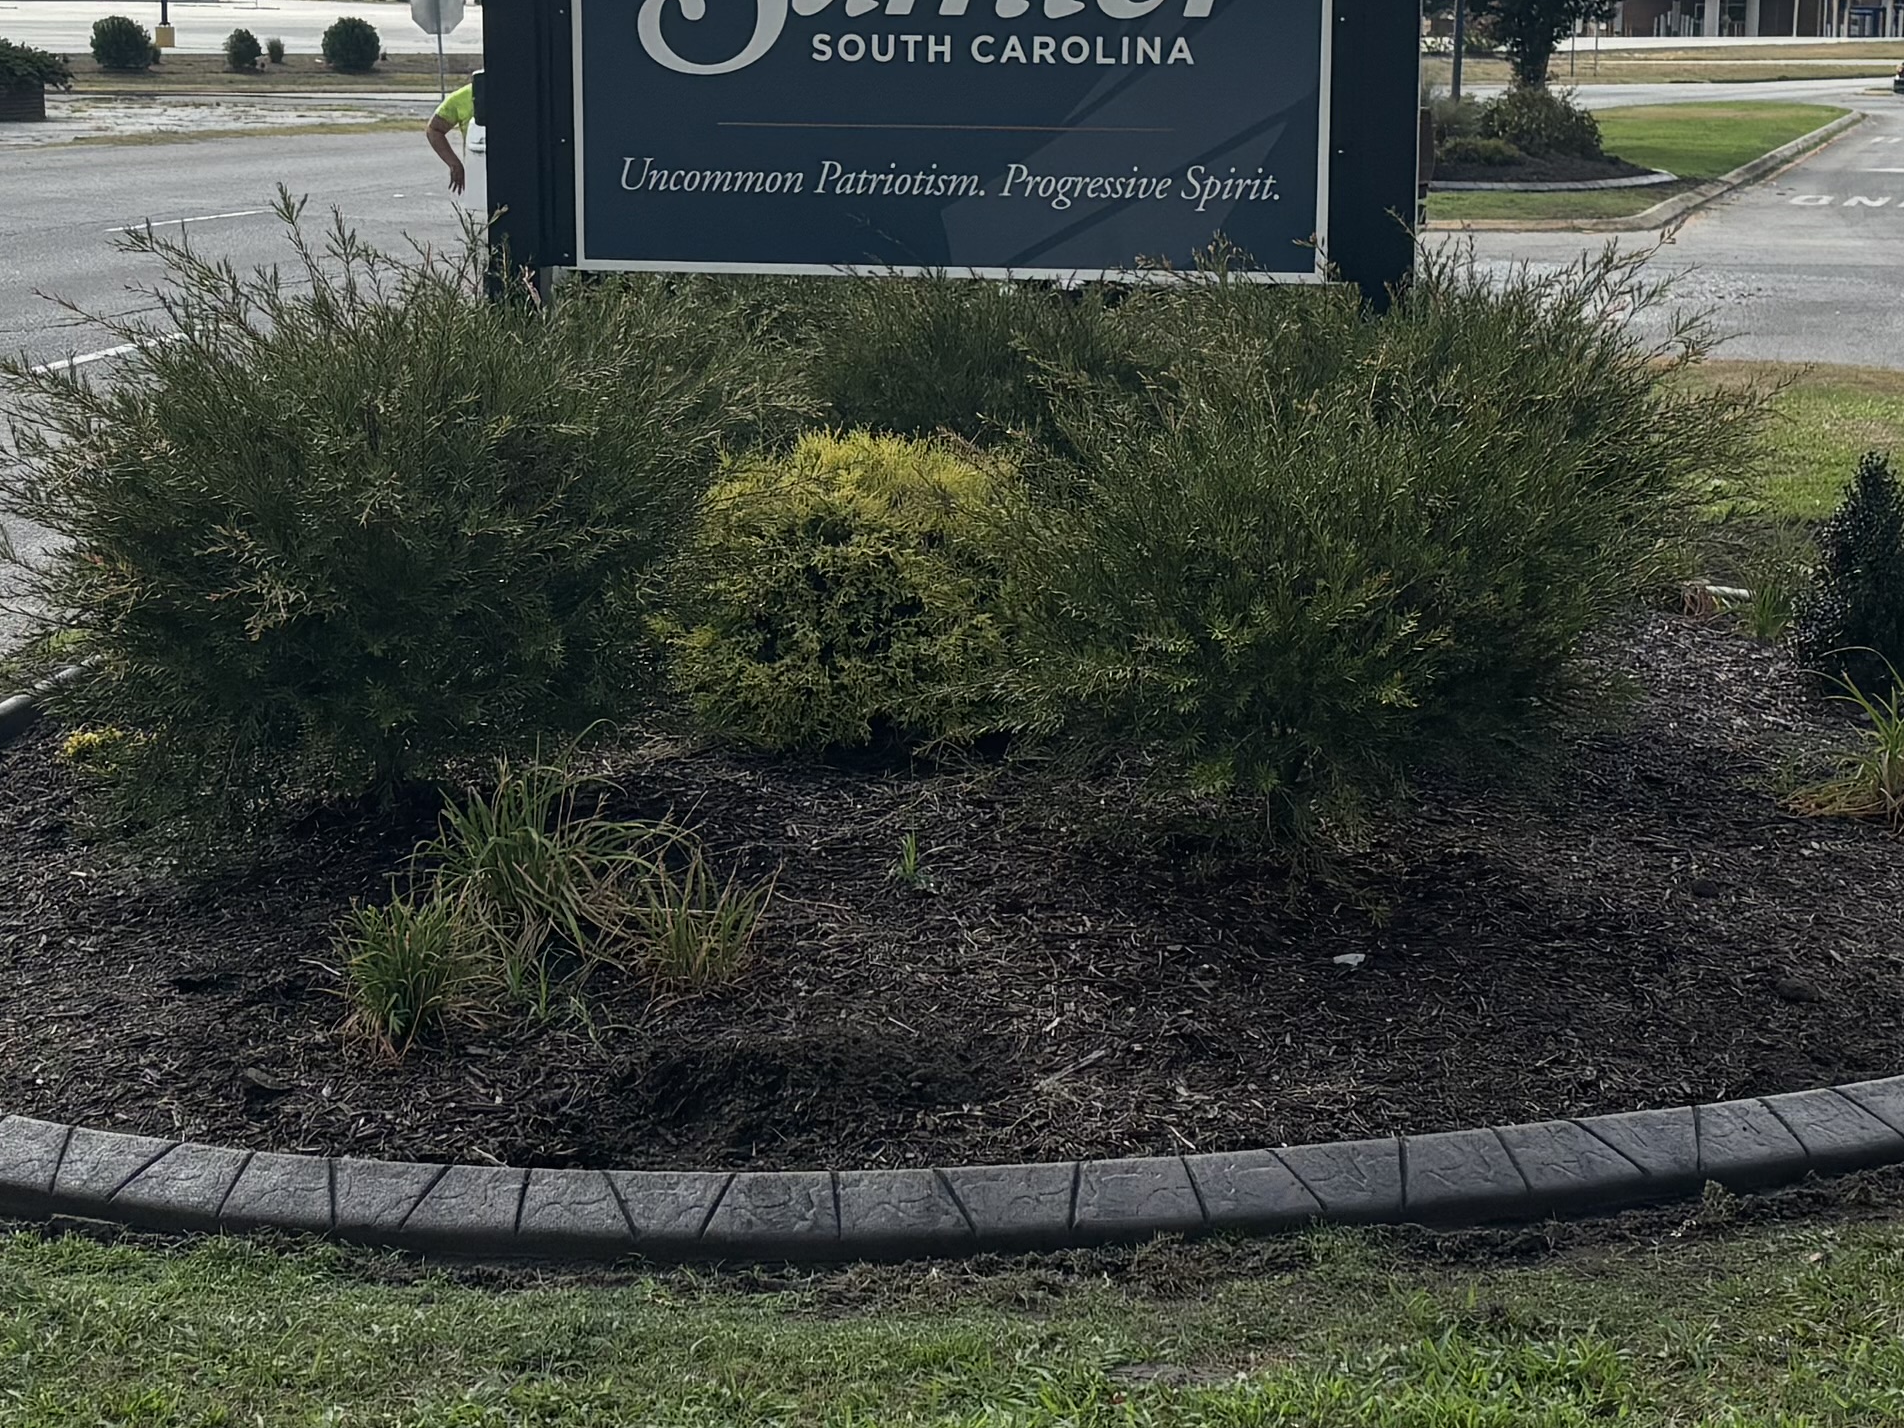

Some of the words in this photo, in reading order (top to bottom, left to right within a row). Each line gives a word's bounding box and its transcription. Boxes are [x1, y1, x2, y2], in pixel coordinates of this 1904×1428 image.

[812, 34, 951, 63] SOUTH
[970, 35, 1195, 65] CAROLINA
[620, 157, 803, 195] Uncommon
[813, 160, 987, 199] Patriotism.
[1000, 163, 1173, 210] Progressive
[1179, 165, 1282, 211] Spirit.
